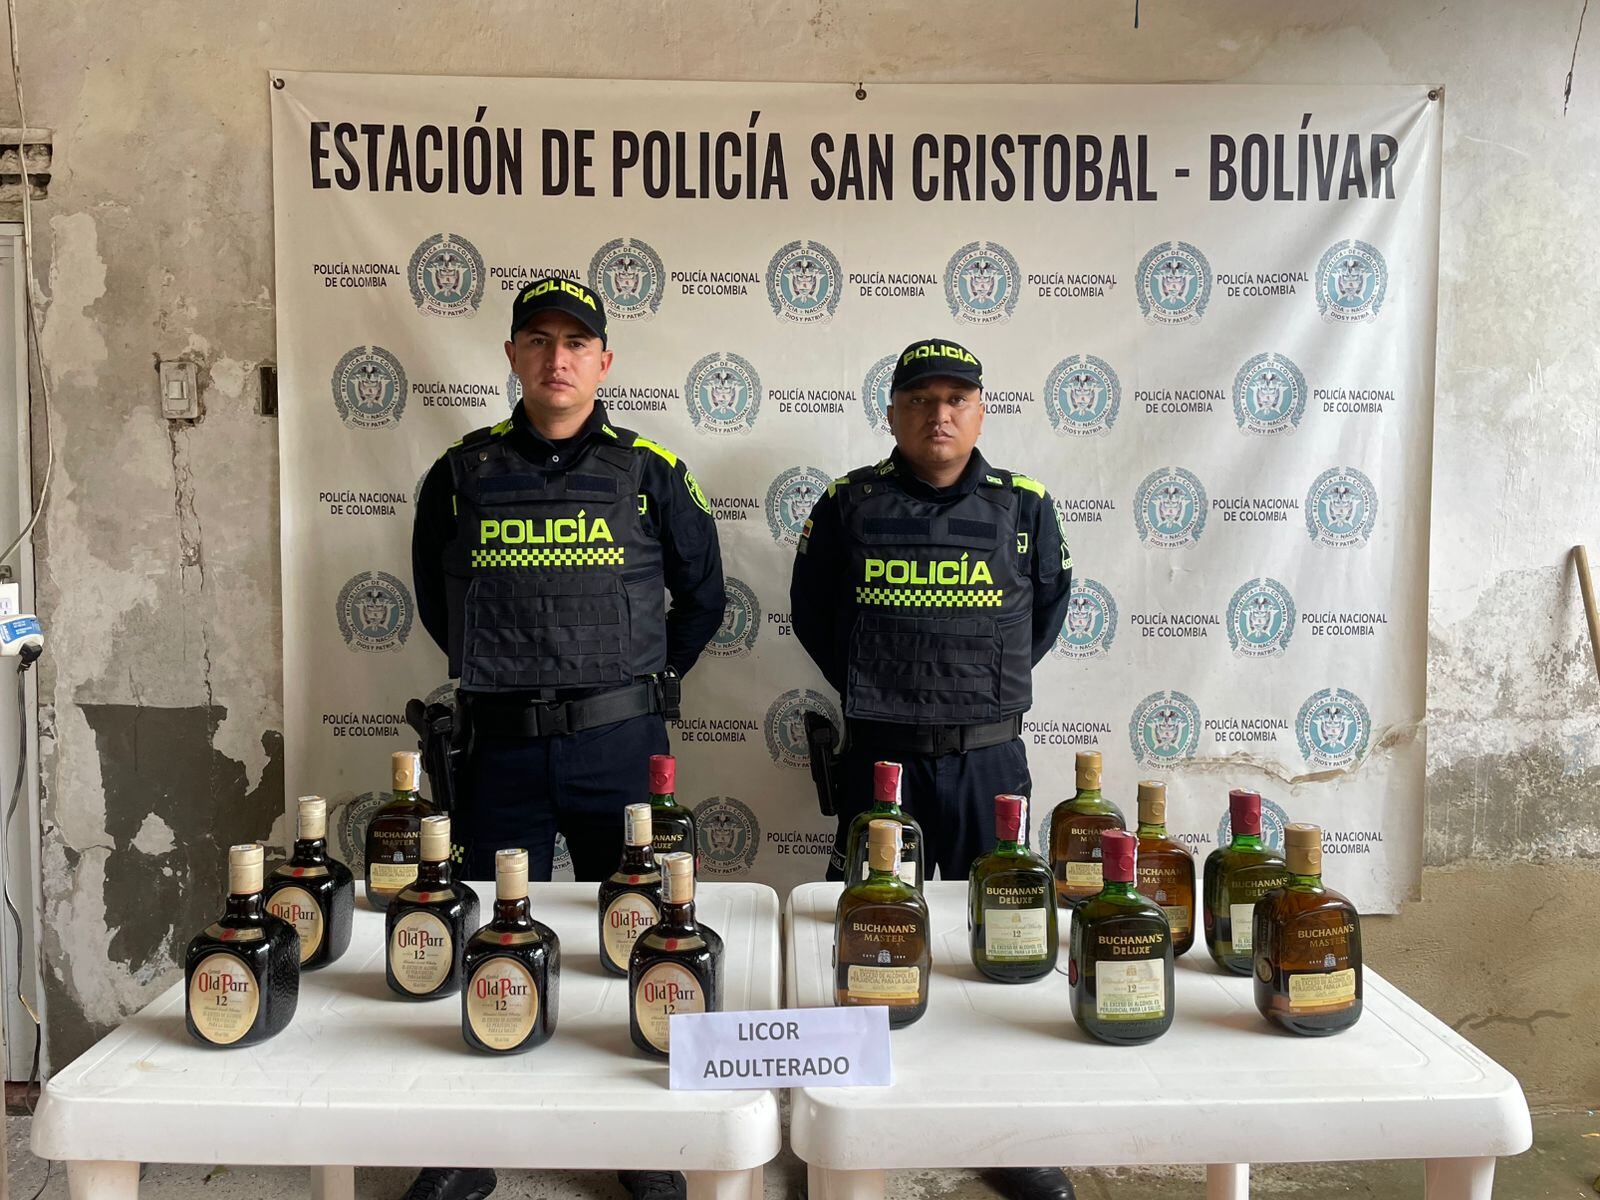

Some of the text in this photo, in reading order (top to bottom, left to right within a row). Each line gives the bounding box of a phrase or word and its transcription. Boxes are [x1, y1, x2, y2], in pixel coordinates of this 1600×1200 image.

[310, 106, 522, 195] ESTACIÓN
[542, 129, 595, 196] DE
[613, 111, 788, 199] POLICÍA
[811, 133, 893, 201] SAN
[913, 134, 1157, 201] CRISTOBAL
[1209, 113, 1398, 201] BOLÍVAR
[314, 262, 400, 274] POLICÍA NACIONAL
[491, 266, 580, 279] POLICÍA NACIONAL
[671, 270, 760, 282] POLICÍA NACIONAL
[850, 272, 937, 284] POLICÍA NACIONAL
[1028, 272, 1117, 287] POLICÍA NACIONAL
[1217, 272, 1308, 284] POLICÍA NACIONAL
[325, 277, 387, 287] DE COLOMBIA
[501, 281, 514, 290] DE
[682, 285, 747, 295] DE COLOMBIA
[860, 287, 925, 296] DE COLOMBIA
[1039, 287, 1104, 297] DE COLOMBIA
[1228, 285, 1295, 296] DE COLOMBIA
[785, 312, 798, 322] DIOS
[804, 313, 824, 322] PATRIA
[413, 382, 499, 395] POLICÍA NACIONAL
[597, 385, 679, 398] OLICÍA NACIONAL
[769, 388, 856, 400] POLICÍA NACIONAL
[985, 392, 1034, 401] NACIONAL
[1135, 389, 1225, 401] POLICÍA NACIONAL
[1314, 390, 1395, 400] POLICÍA NACIONAL
[423, 396, 486, 407] DE COLOMBIA
[603, 400, 667, 410] DE COLOMBIA
[780, 403, 844, 413] DE COLOMBIA
[985, 404, 1021, 414] LOMBIA
[1146, 403, 1213, 413] DE COLOMBIA
[1324, 402, 1382, 413] DE COLOMBIA
[320, 490, 407, 503] POLICÍA NACIONAL
[710, 498, 759, 508] NACIONAL
[1065, 500, 1115, 509] NACIONAL
[1213, 497, 1299, 509] POLICÍA NACIONAL
[331, 505, 396, 515] DE COLOMBIA
[1224, 511, 1287, 521] DE COLOMBIA
[480, 509, 613, 544] POLICÍA
[865, 552, 993, 585] POLICÍA
[768, 613, 793, 623] POLIC
[1131, 613, 1219, 625] POLICÍA NACIONAL
[1302, 611, 1387, 623] POLICÍA NACIONAL
[778, 626, 791, 635] DE
[1143, 627, 1207, 637] DE COLOMBIA
[1312, 626, 1374, 635] DE COLOMBIA
[323, 713, 406, 724] POLICÍA NACIONA
[671, 717, 758, 730] POLICÍA NACIONAL
[1205, 717, 1288, 729] POLICÍA NACIONAL
[334, 727, 399, 736] DE COLOMBIA
[1023, 720, 1111, 732] POLICÍA NACIONAL
[682, 732, 746, 742] DE COLOMBIA
[1034, 735, 1098, 744] DE COLOMBIA
[1215, 731, 1277, 741] DE COLOMBIA
[767, 831, 835, 843] POLICÍA NACIO
[1335, 832, 1383, 841] NACIONAL
[777, 845, 833, 854] DE COLOMB
[1322, 844, 1370, 854] COLOMBIA
[986, 886, 1045, 895] BUCHANAN'S
[291, 905, 315, 922] Parr
[611, 911, 654, 929] Old Parr
[853, 922, 917, 934] BUCHANAN'S
[1297, 923, 1355, 939] BUCHANAN'S
[398, 930, 444, 949] Old Parr
[626, 930, 637, 939] 12
[864, 933, 907, 943] MASTER
[1012, 930, 1021, 938] 12
[1098, 934, 1162, 945] BUCHANAN'S
[1309, 936, 1347, 948] MASTER
[414, 950, 425, 960] 12
[199, 972, 249, 994] Old Parr
[477, 978, 527, 999] Old Parr
[1127, 984, 1137, 993] 12
[644, 982, 695, 1003] Old Parr
[216, 995, 228, 1006] 12
[495, 1000, 507, 1010] 12
[663, 1004, 675, 1015] 12
[739, 1022, 799, 1041] LICOR
[704, 1057, 849, 1078] ADULTERADO
